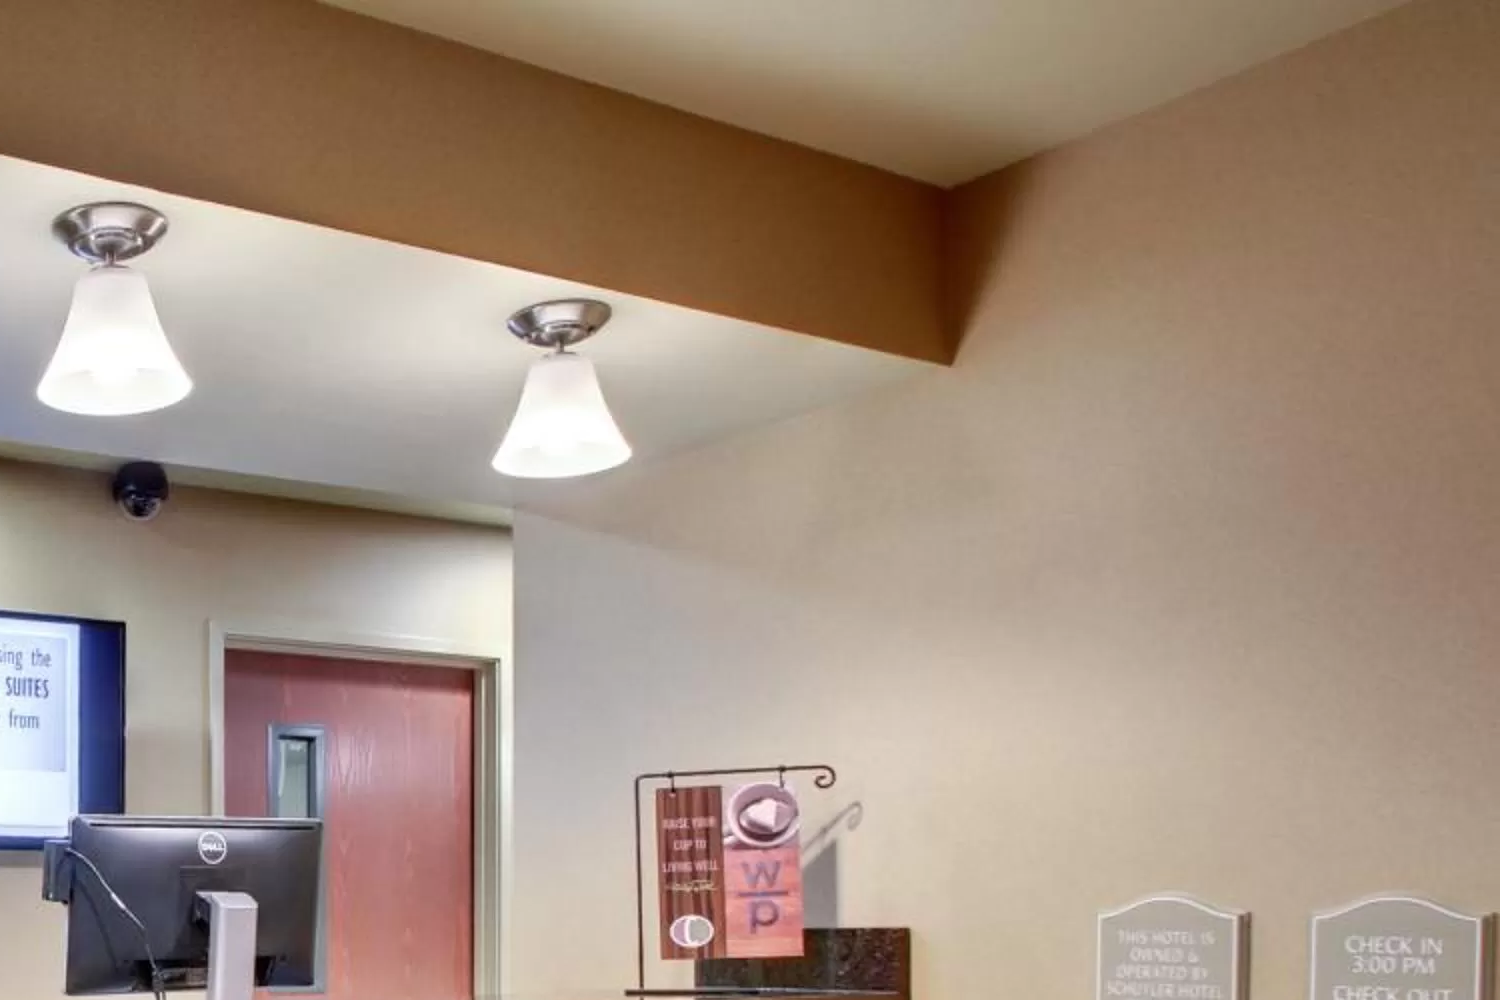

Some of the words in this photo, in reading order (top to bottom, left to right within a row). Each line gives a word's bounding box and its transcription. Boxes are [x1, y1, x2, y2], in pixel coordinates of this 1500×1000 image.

[31, 648, 52, 667] the
[6, 676, 49, 699] SUITES
[9, 708, 40, 729] from
[673, 839, 692, 851] CUP
[694, 838, 707, 850] TO
[1118, 929, 1147, 945] THIS
[1151, 930, 1196, 945] HOTEL
[1200, 931, 1216, 945] IS
[1343, 935, 1414, 954] CHECK
[1420, 936, 1443, 956] IN
[1129, 947, 1184, 962] OWNED
[1115, 964, 1188, 979] OPERATED
[1350, 955, 1396, 974] 3:00
[1402, 957, 1436, 976] PM
[1177, 983, 1223, 1000] HOTEL
